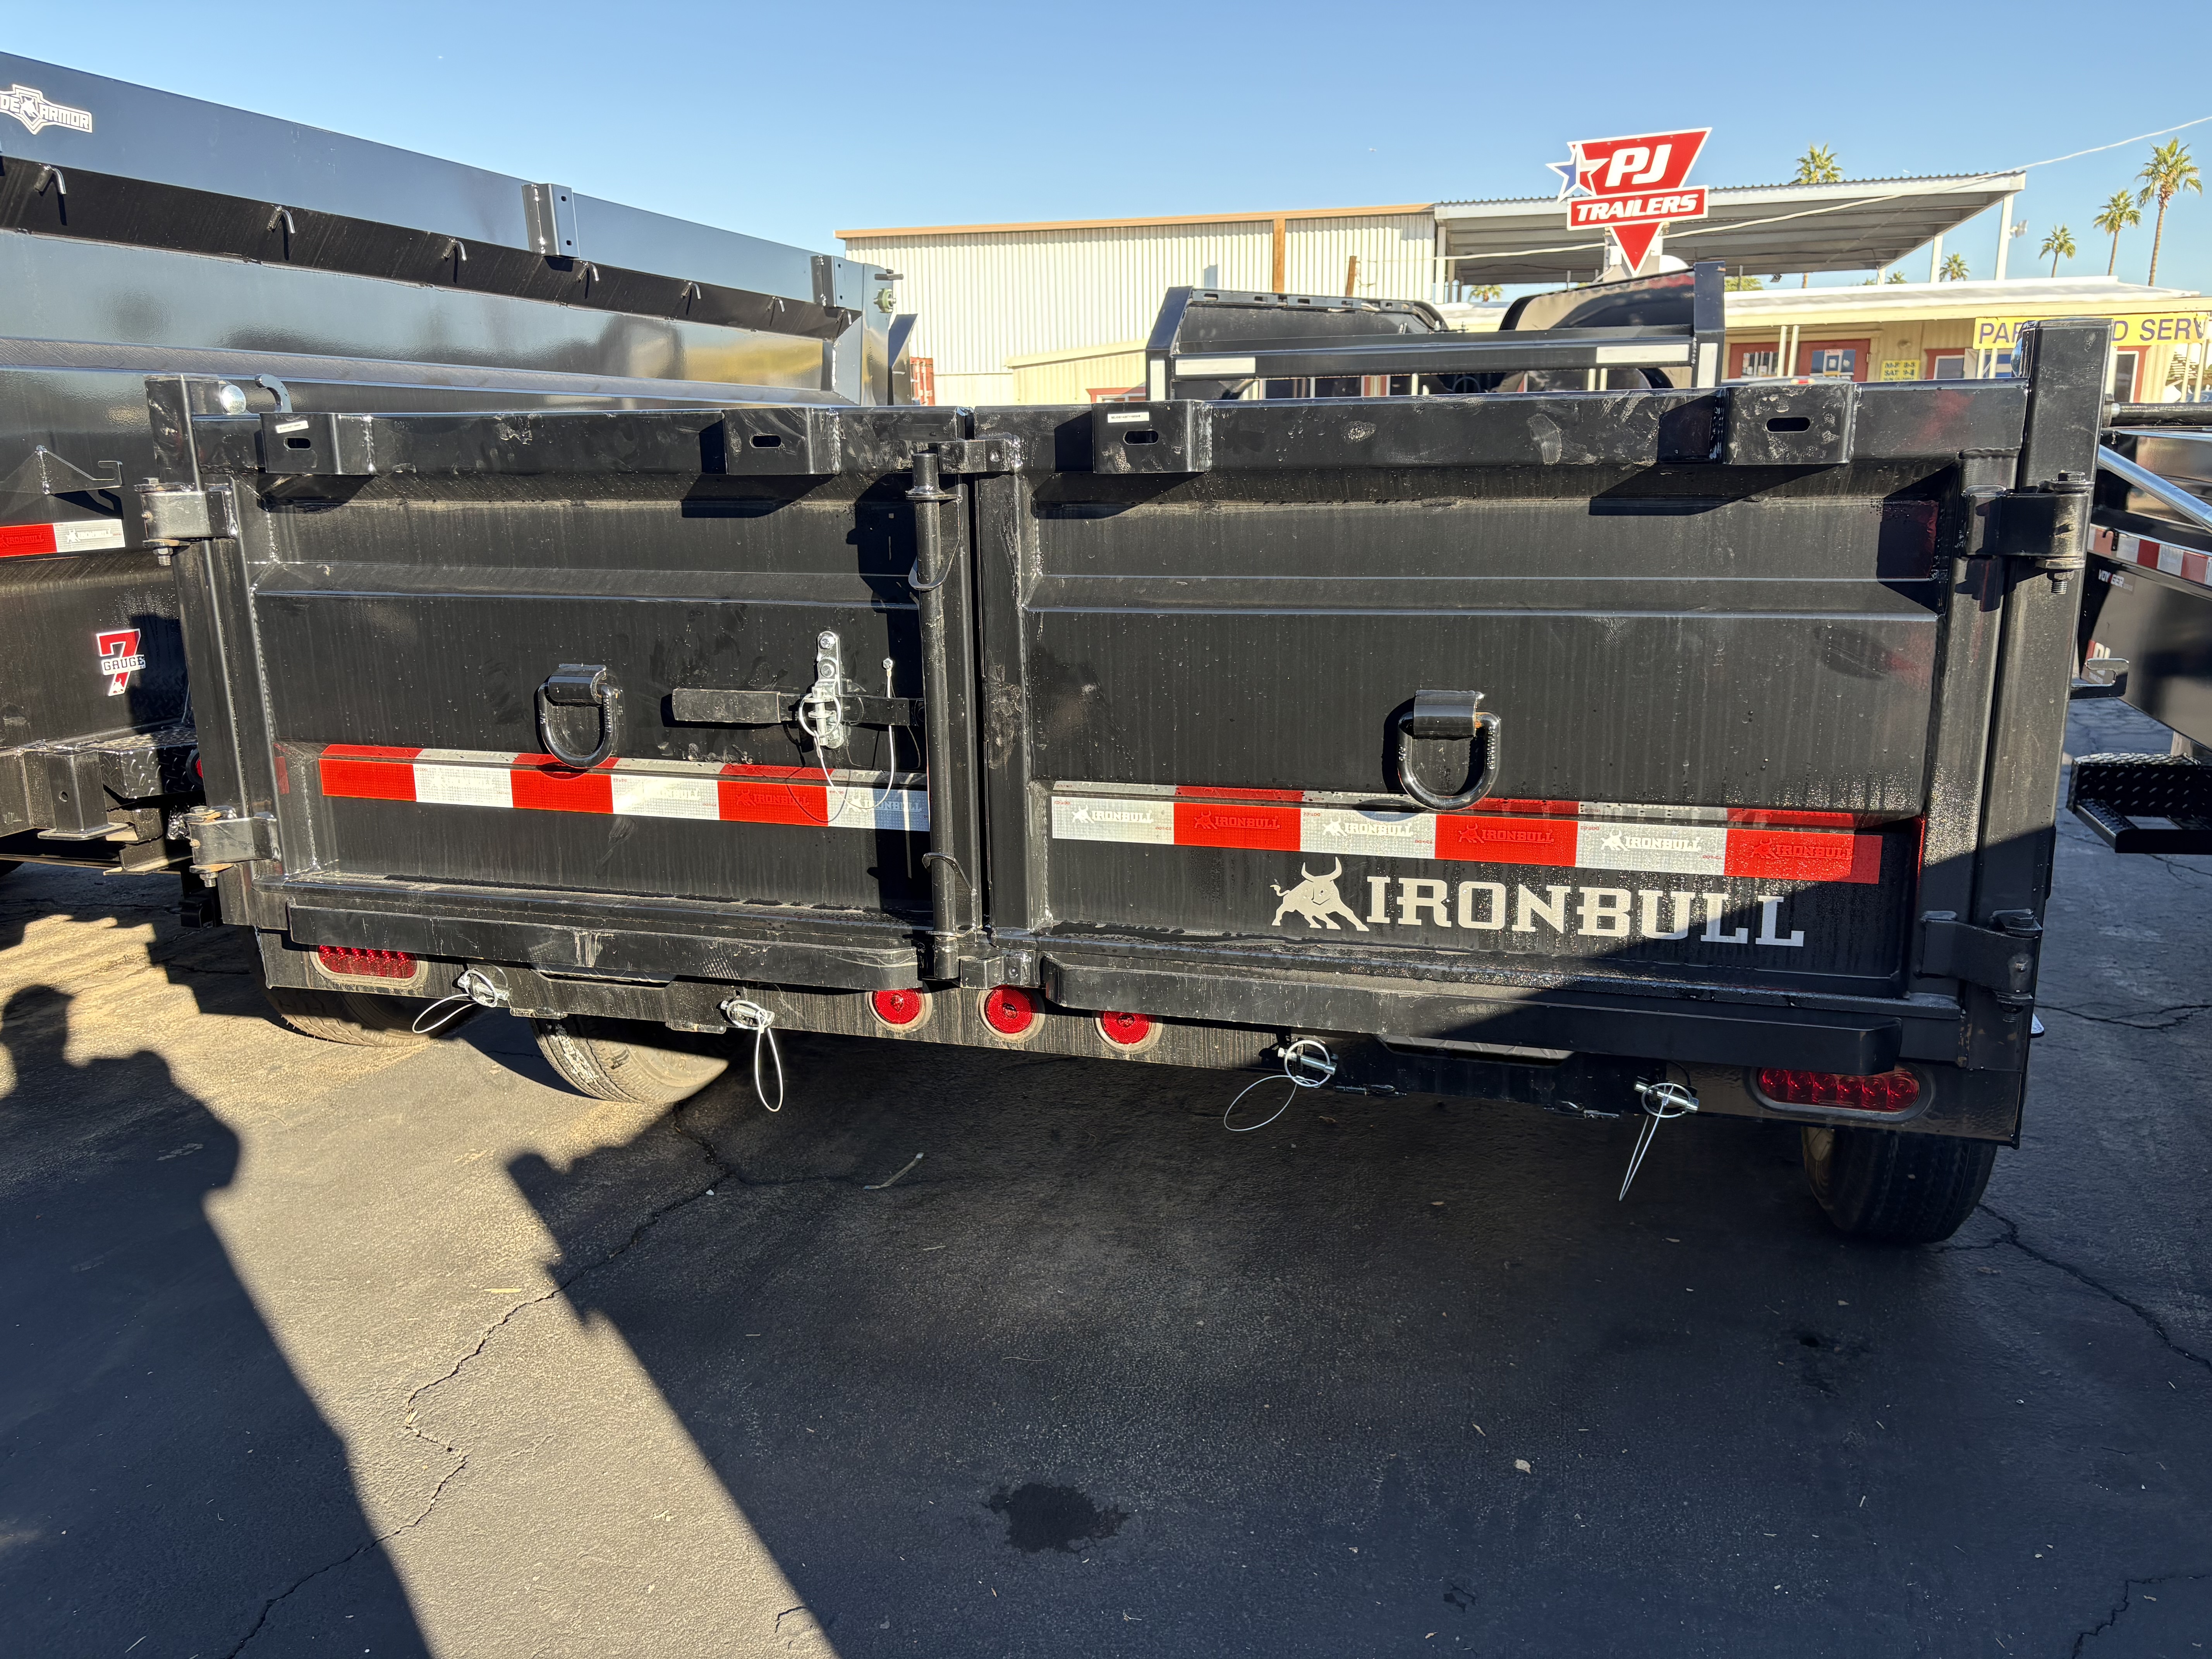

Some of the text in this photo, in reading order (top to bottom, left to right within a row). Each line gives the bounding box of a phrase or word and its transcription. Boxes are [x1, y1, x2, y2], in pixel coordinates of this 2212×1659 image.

[39, 105, 89, 129] ARMOR
[1604, 144, 1672, 187] PJ
[1577, 194, 1699, 222] TRAILERS
[96, 629, 141, 696] 7
[103, 654, 145, 671] GAUGE
[753, 794, 809, 805] IRONBULL
[1092, 810, 1154, 823] IRONBULL
[1214, 816, 1280, 828] IRONBULL
[1344, 822, 1413, 836] IRONBULL
[1482, 829, 1554, 842] IRONBULL
[1625, 836, 1702, 852] IRONBULL
[1367, 876, 1805, 947] IRONBULL
